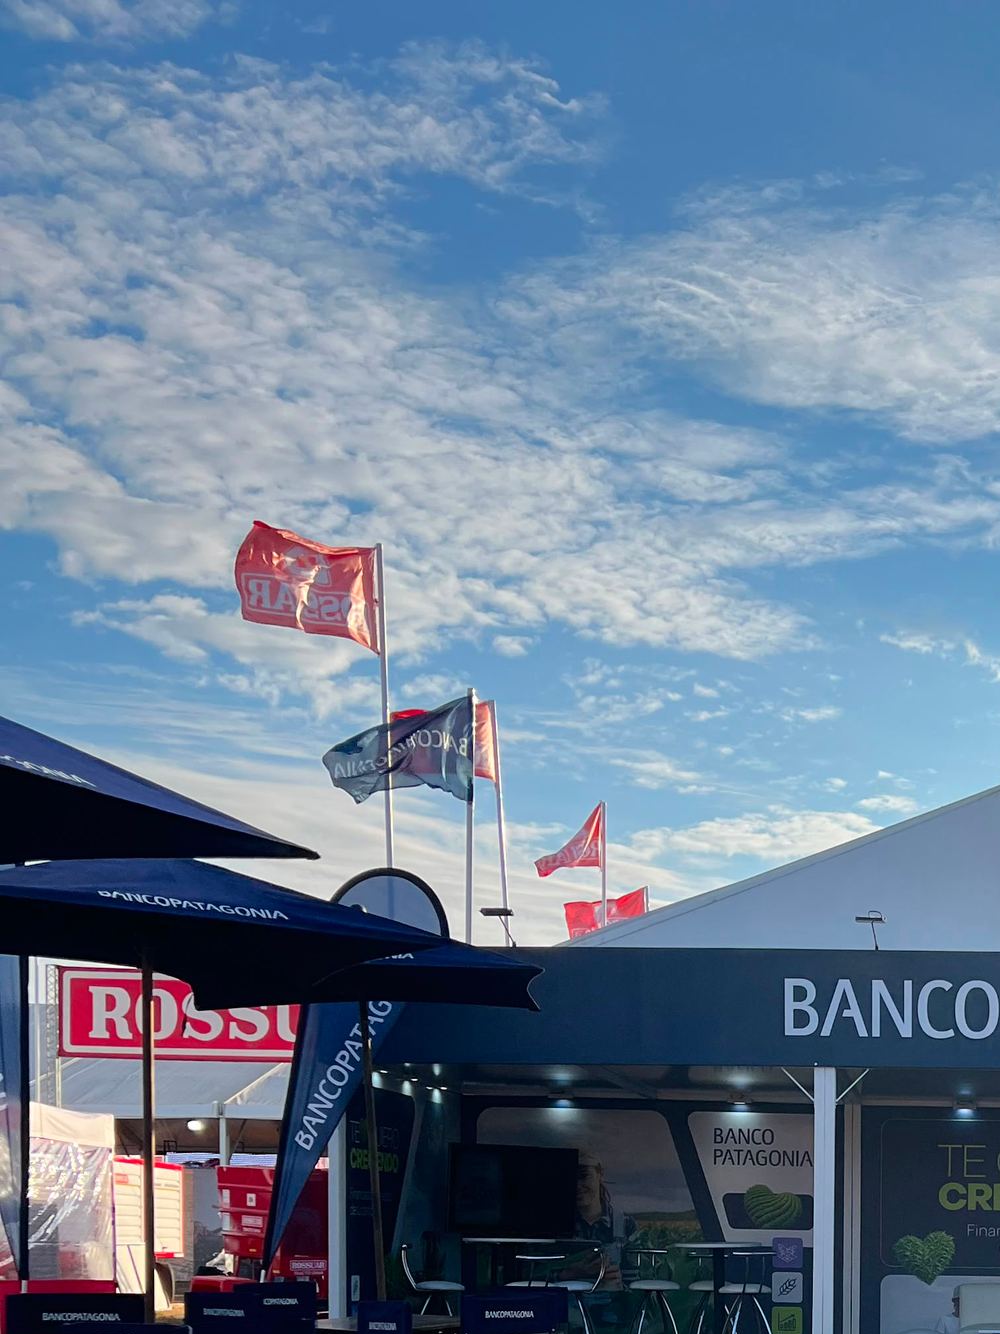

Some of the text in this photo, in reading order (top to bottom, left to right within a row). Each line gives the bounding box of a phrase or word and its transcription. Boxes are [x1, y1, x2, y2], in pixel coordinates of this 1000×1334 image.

[713, 1127, 774, 1146] BANCO
[713, 1148, 813, 1168] PATAGONIA
[937, 1144, 987, 1178] TE
[42, 1312, 120, 1321] BANCOPATAGONIA
[485, 1310, 534, 1319] BANCOPATAGONIA
